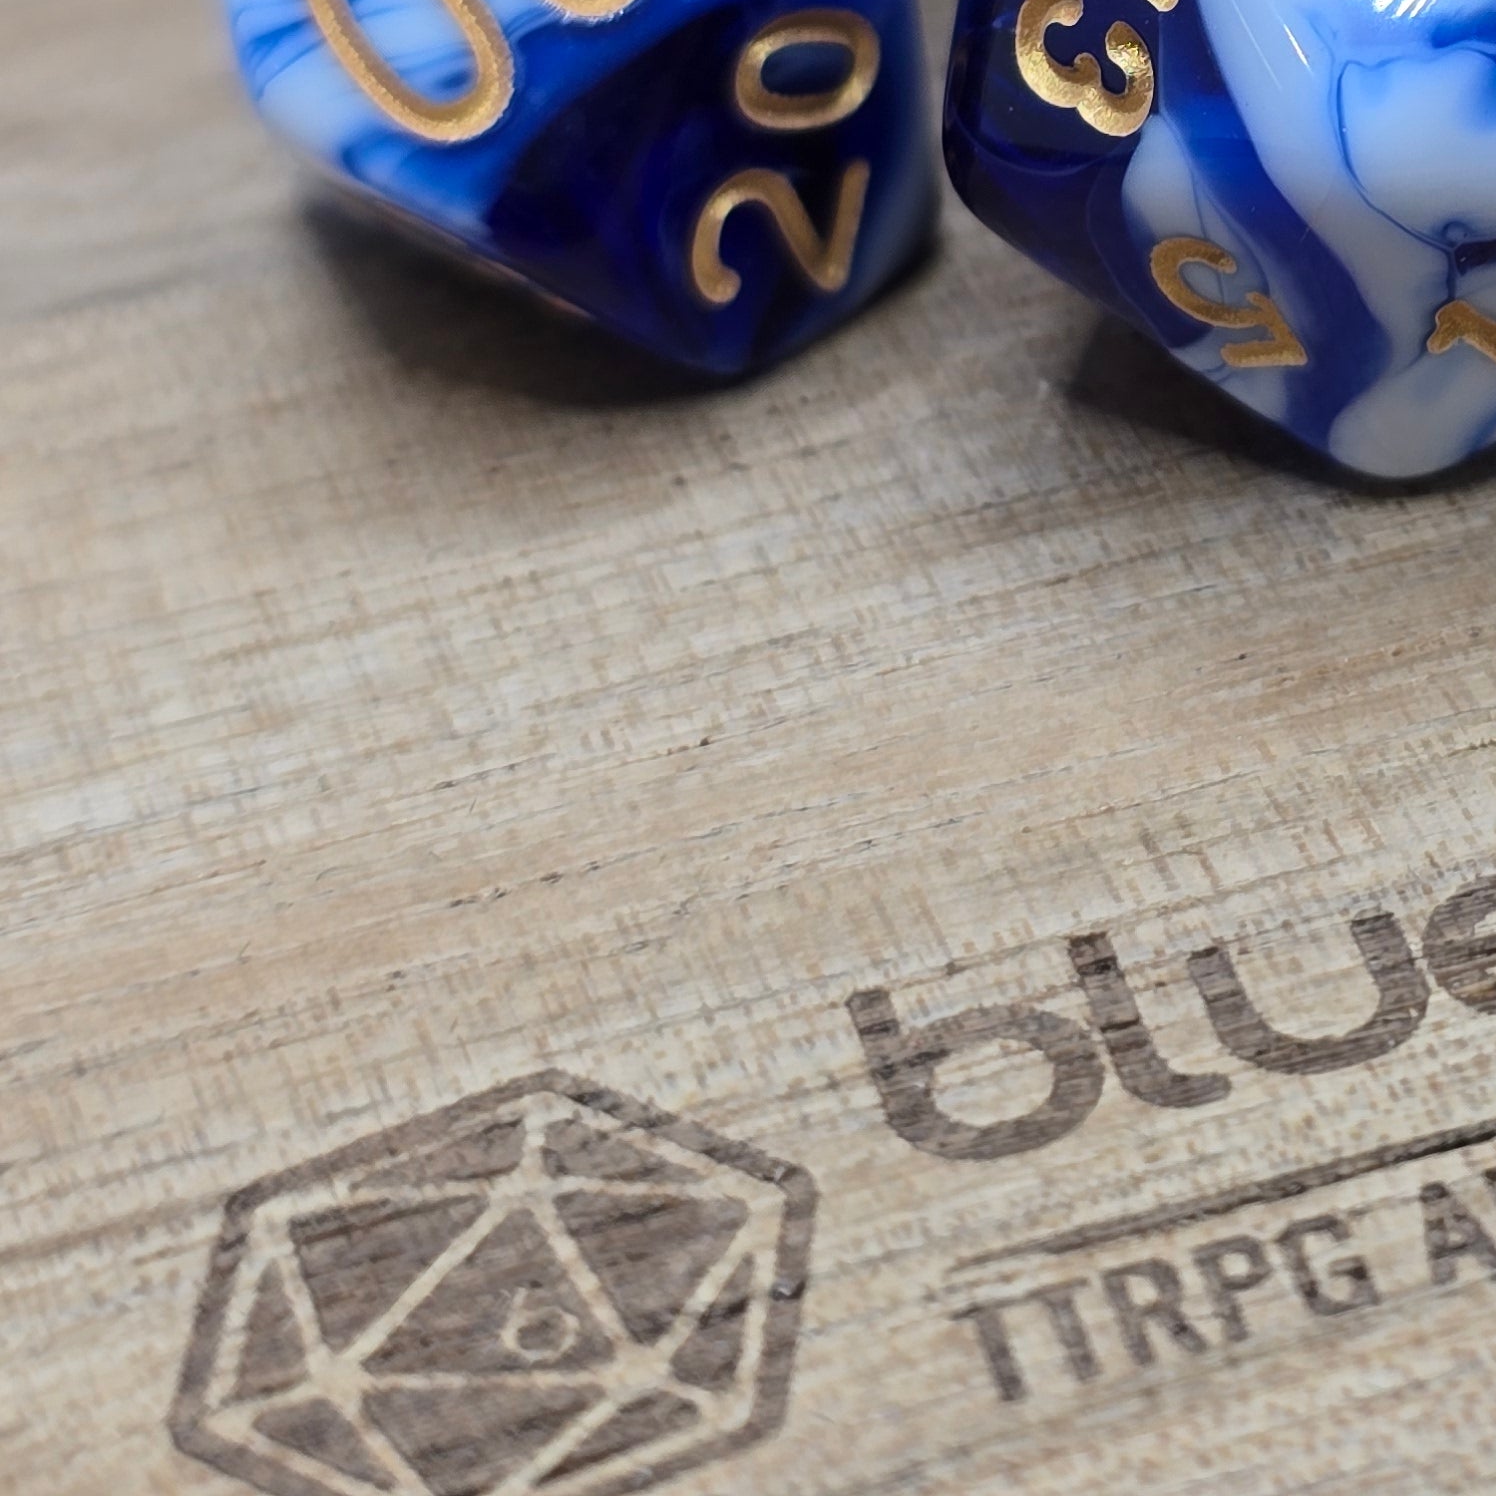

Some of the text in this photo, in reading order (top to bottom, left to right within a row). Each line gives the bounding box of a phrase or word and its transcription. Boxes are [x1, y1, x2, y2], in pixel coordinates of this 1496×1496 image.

[690, 9, 880, 304] 20
[1148, 236, 1308, 369] 5
[950, 1212, 1382, 1404] TTRPG
